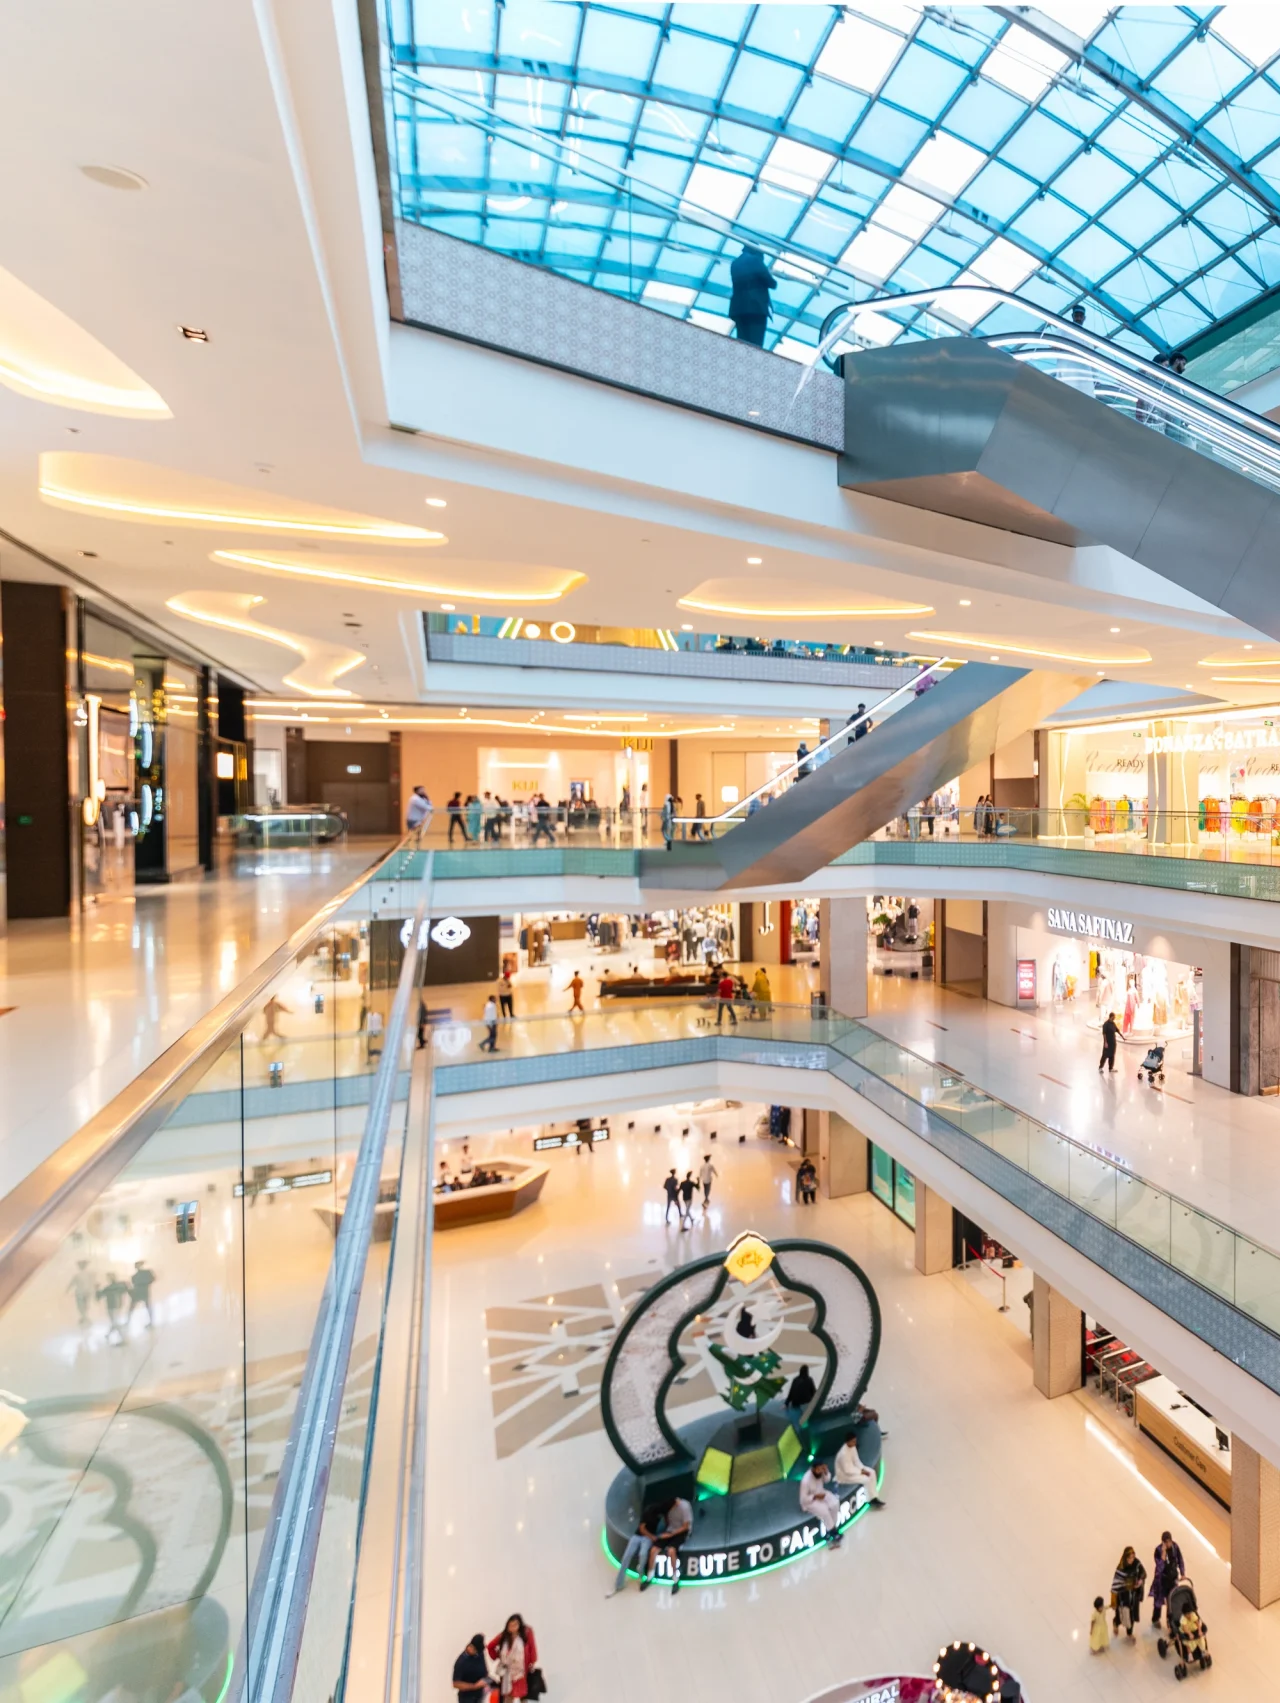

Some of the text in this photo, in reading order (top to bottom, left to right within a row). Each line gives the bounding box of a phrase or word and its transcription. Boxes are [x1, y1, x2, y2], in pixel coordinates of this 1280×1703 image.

[1145, 734, 1213, 754] BONANZA
[1117, 758, 1145, 768] READY
[1047, 907, 1135, 944] SANA SAFINAZ
[746, 1543, 773, 1568] TO
